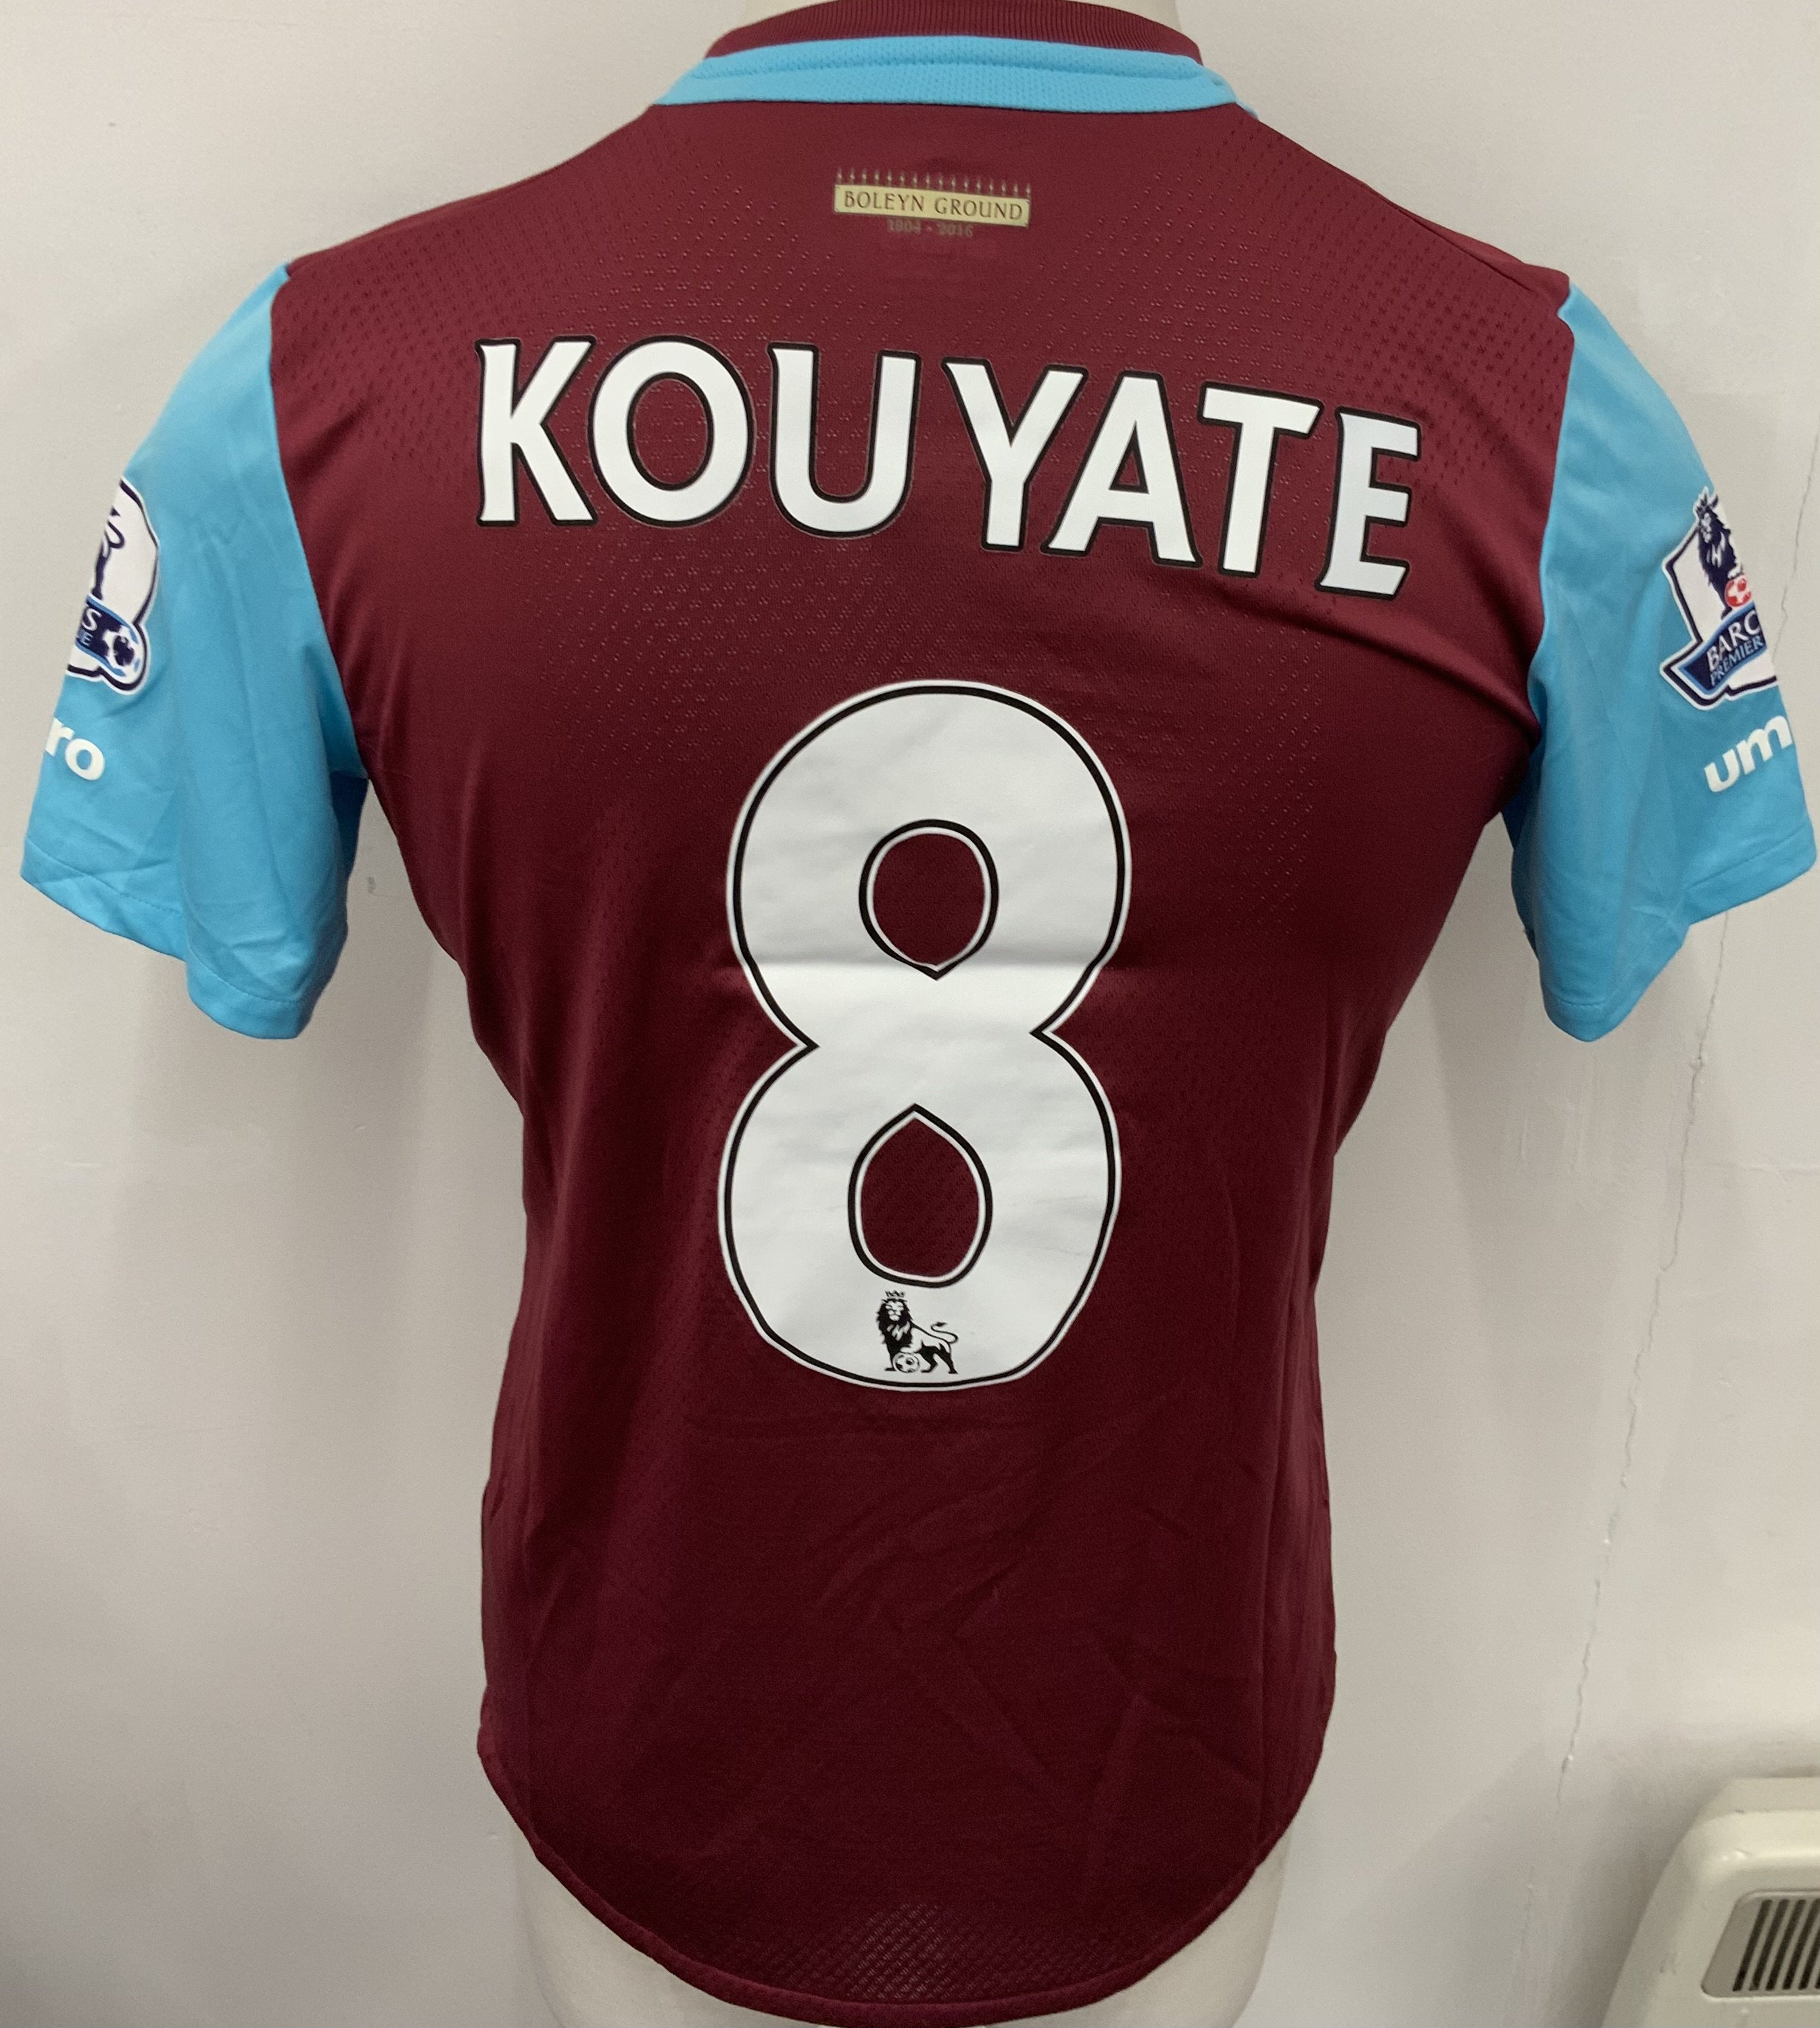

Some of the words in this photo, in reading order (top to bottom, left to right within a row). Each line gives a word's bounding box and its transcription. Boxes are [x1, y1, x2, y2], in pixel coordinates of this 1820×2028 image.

[844, 191, 925, 212] BOLEYN
[934, 197, 1023, 220] GROUND
[936, 222, 974, 238] 2016
[475, 335, 1423, 599] KOUYATE
[1709, 636, 1764, 687] PREMIER
[717, 679, 1132, 1392] 8
